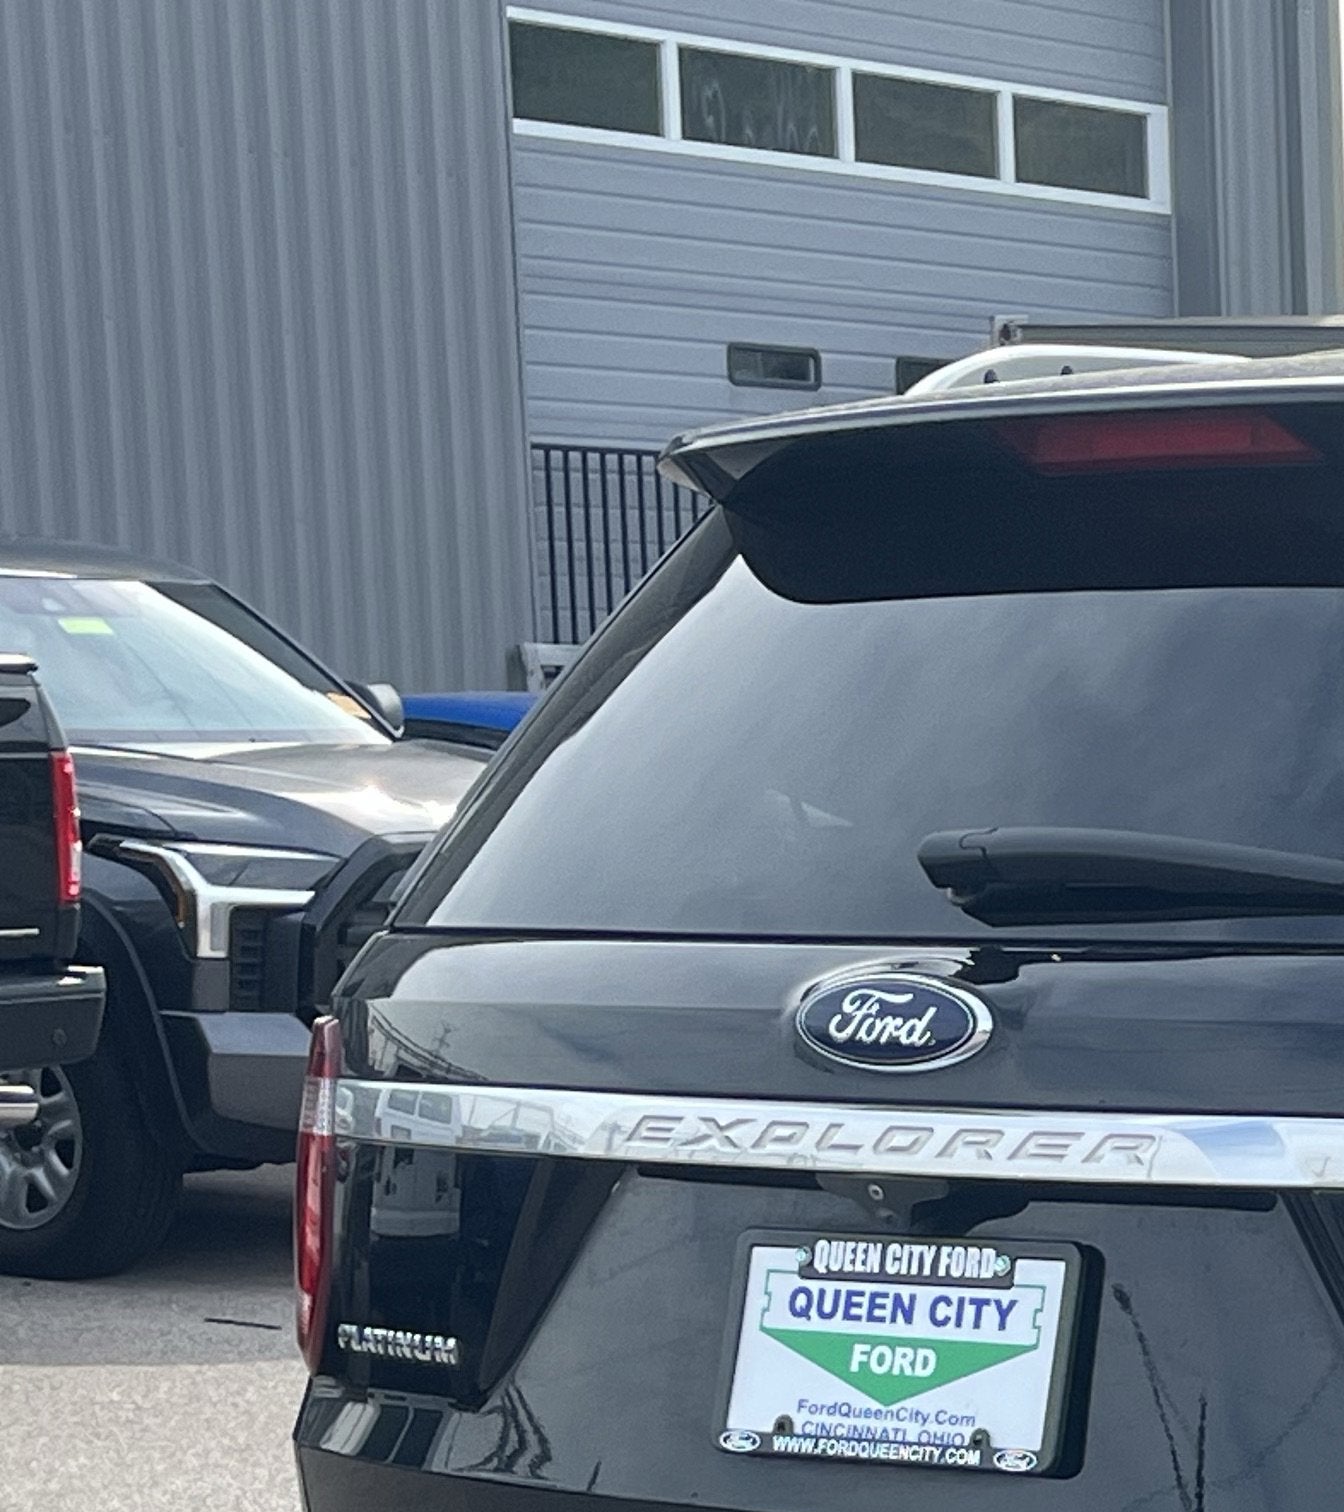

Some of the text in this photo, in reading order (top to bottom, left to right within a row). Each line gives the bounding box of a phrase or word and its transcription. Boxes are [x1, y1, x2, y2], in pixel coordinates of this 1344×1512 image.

[828, 988, 937, 1048] Ford
[623, 1113, 1158, 1166] EXPLORER
[813, 1240, 997, 1279] QUEEN CITY FORD
[788, 1286, 1018, 1331] QUEEN CITY
[337, 1323, 460, 1365] PLATINUM
[850, 1343, 937, 1377] FORD
[797, 1398, 976, 1428] FordQueenCity.Com
[772, 1435, 981, 1466] WWW.FORDQUEENCITY.COM
[917, 1430, 965, 1447] OHIO
